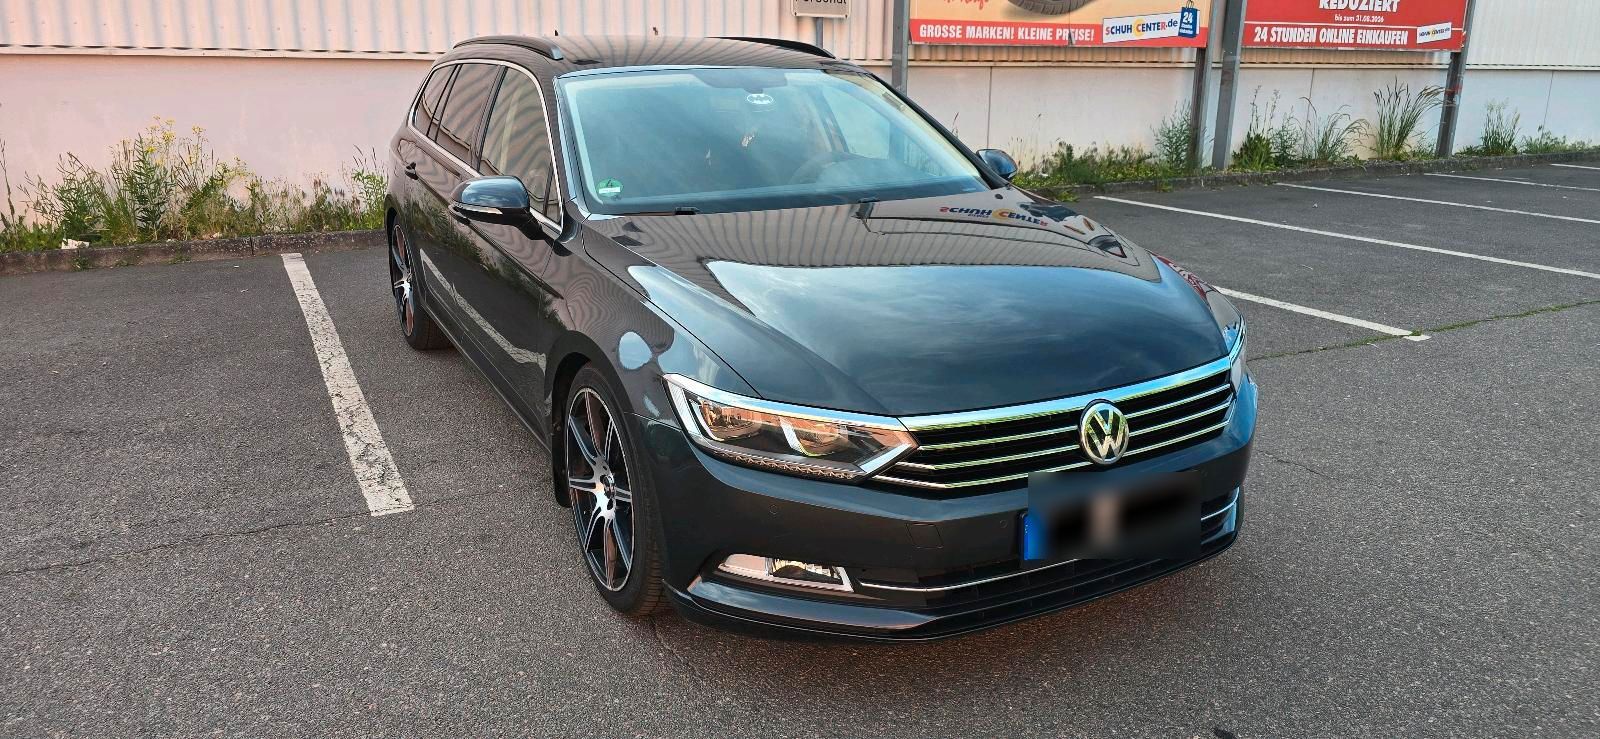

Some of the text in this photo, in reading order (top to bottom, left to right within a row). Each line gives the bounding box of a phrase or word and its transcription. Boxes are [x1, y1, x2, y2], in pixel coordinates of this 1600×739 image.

[1319, 0, 1400, 12] REDUZIERT
[1183, 12, 1193, 24] 24
[919, 24, 962, 38] GROSSE
[965, 26, 1015, 40] MARKEN!
[1018, 27, 1053, 40] KLEINE
[1105, 24, 1133, 36] SCHUH
[1254, 26, 1268, 42] 24
[1270, 27, 1317, 42] STUNDEN
[1319, 28, 1356, 44] ONLINE
[1357, 29, 1408, 45] EINKAUFEN
